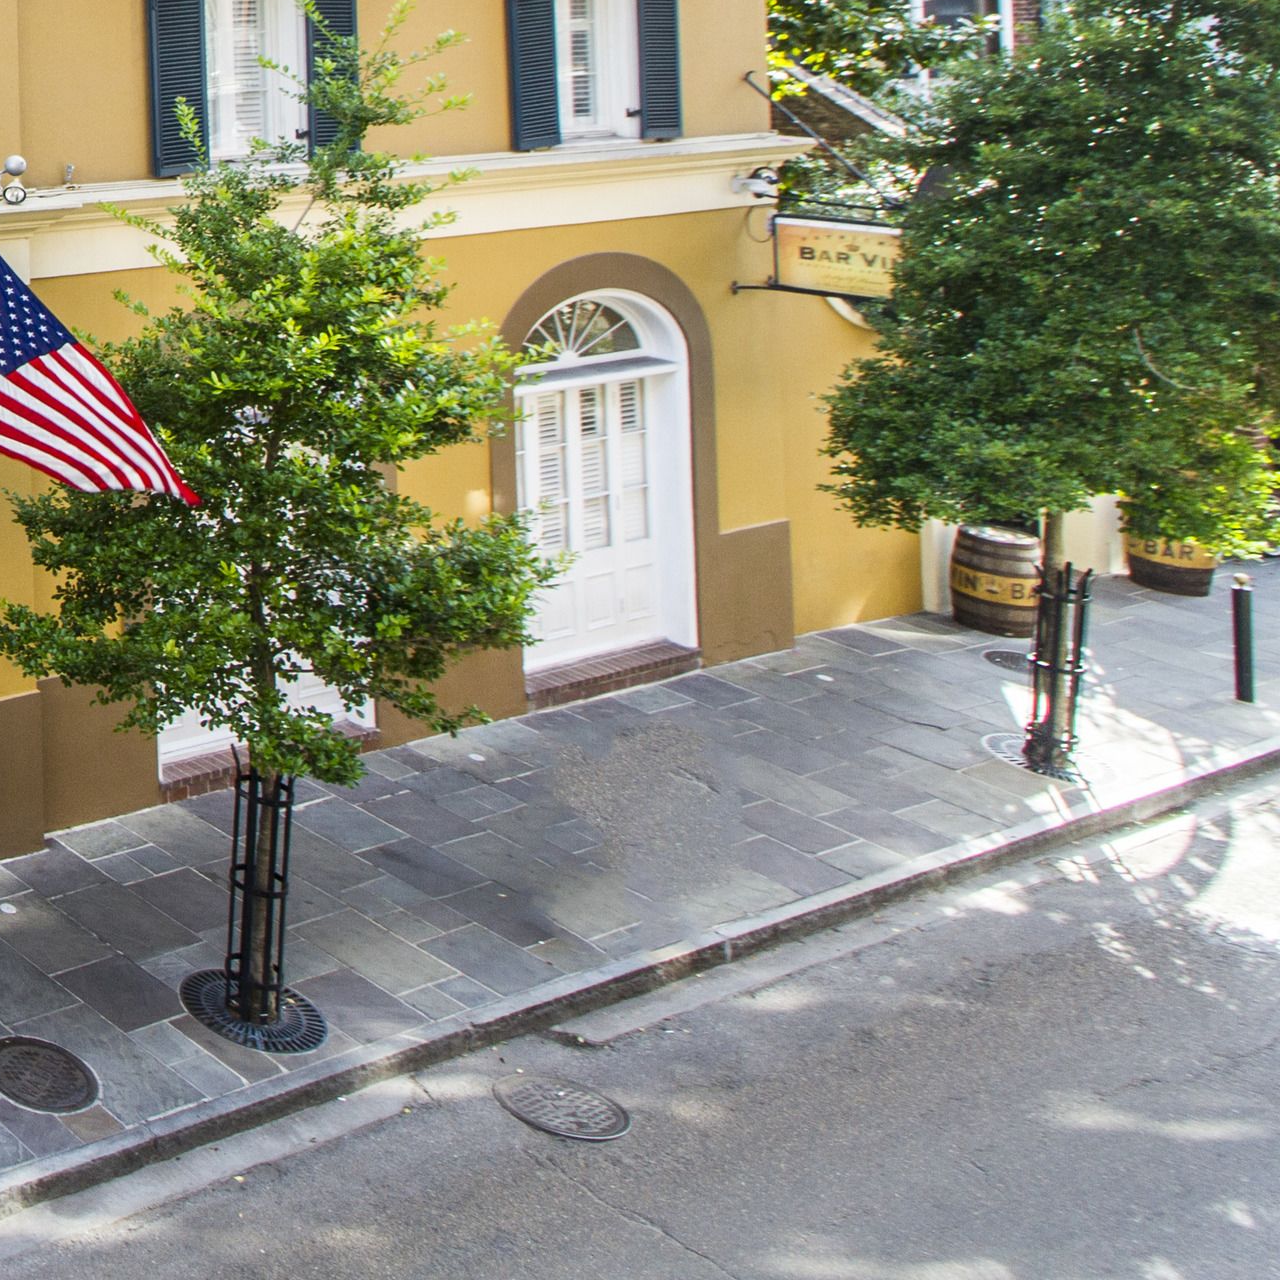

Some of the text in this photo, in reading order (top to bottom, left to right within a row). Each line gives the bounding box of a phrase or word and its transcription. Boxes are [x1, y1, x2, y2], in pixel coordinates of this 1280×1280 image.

[800, 246, 850, 265] BAR
[1145, 539, 1194, 560] BAR
[1011, 583, 1040, 600] BA
